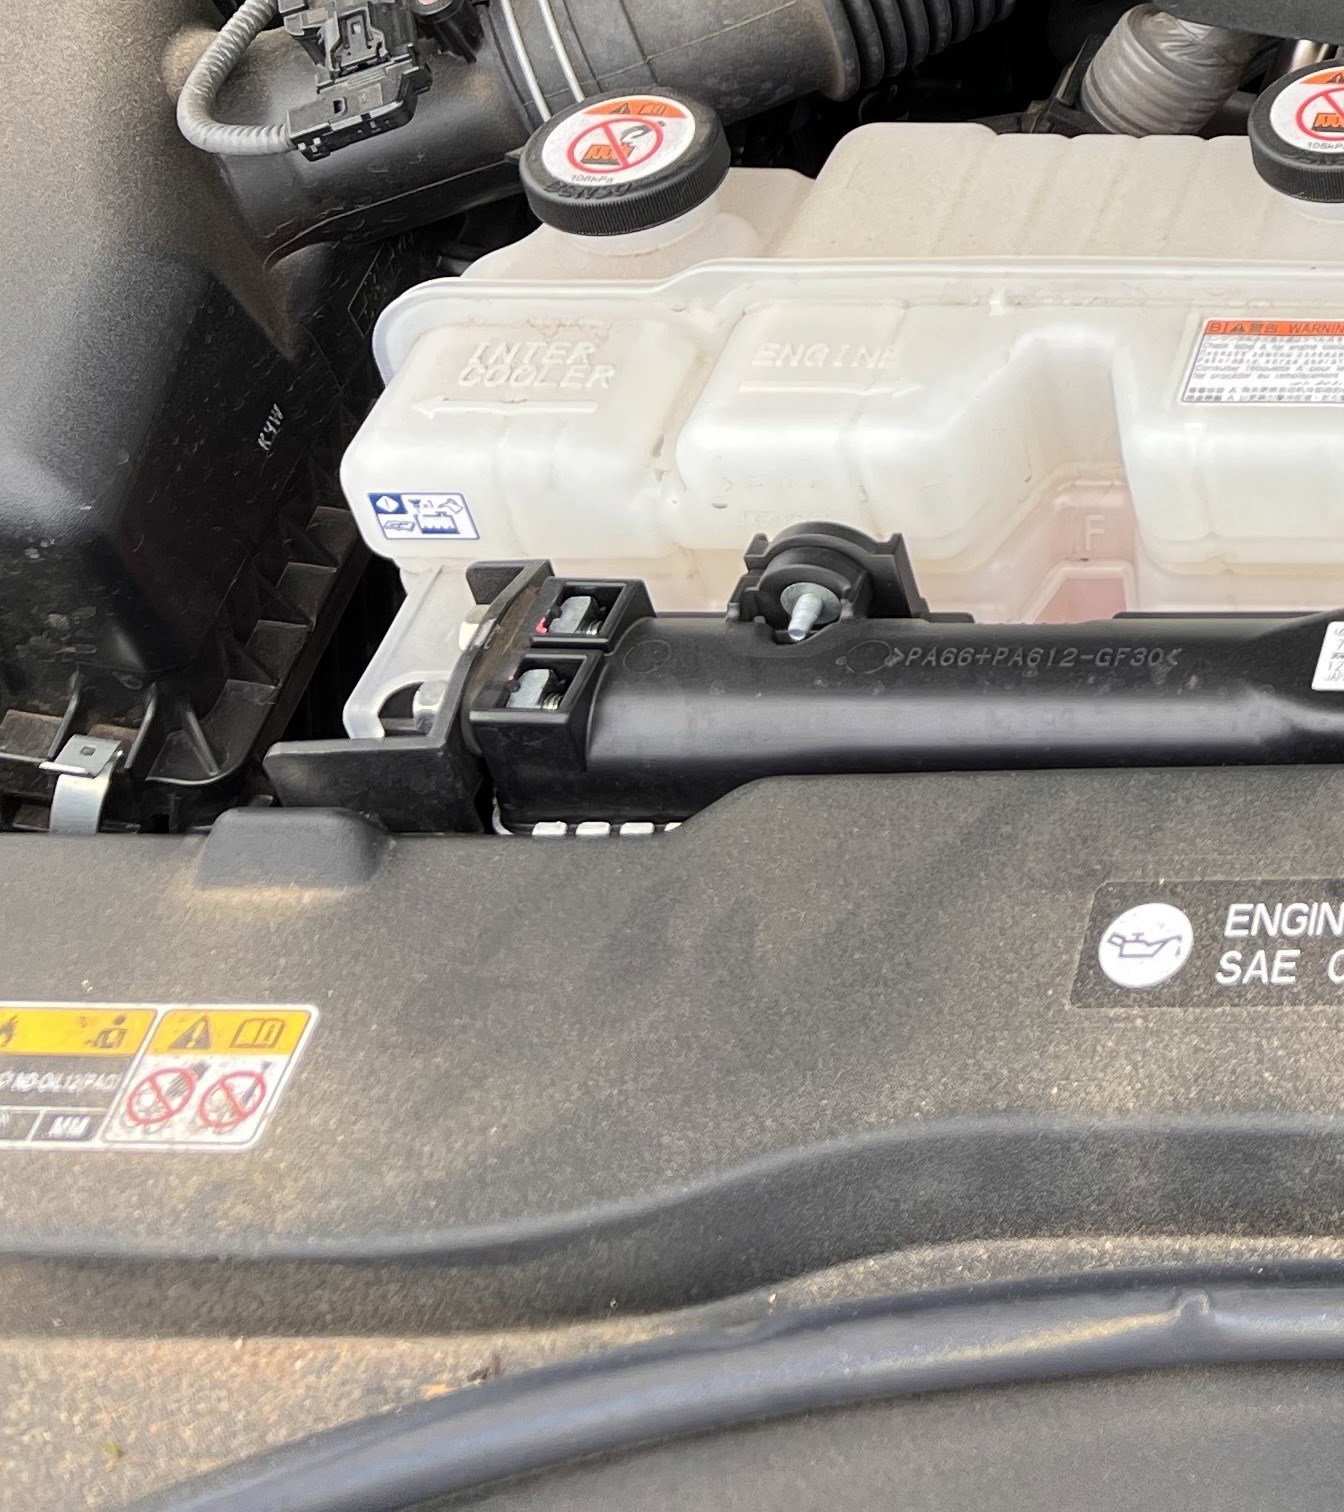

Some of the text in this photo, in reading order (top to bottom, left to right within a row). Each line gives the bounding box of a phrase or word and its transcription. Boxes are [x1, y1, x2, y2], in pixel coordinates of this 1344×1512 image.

[468, 341, 598, 364] INTER
[750, 342, 899, 369] ENGINE
[457, 363, 617, 390] COOLER
[1215, 948, 1301, 985] SAE
